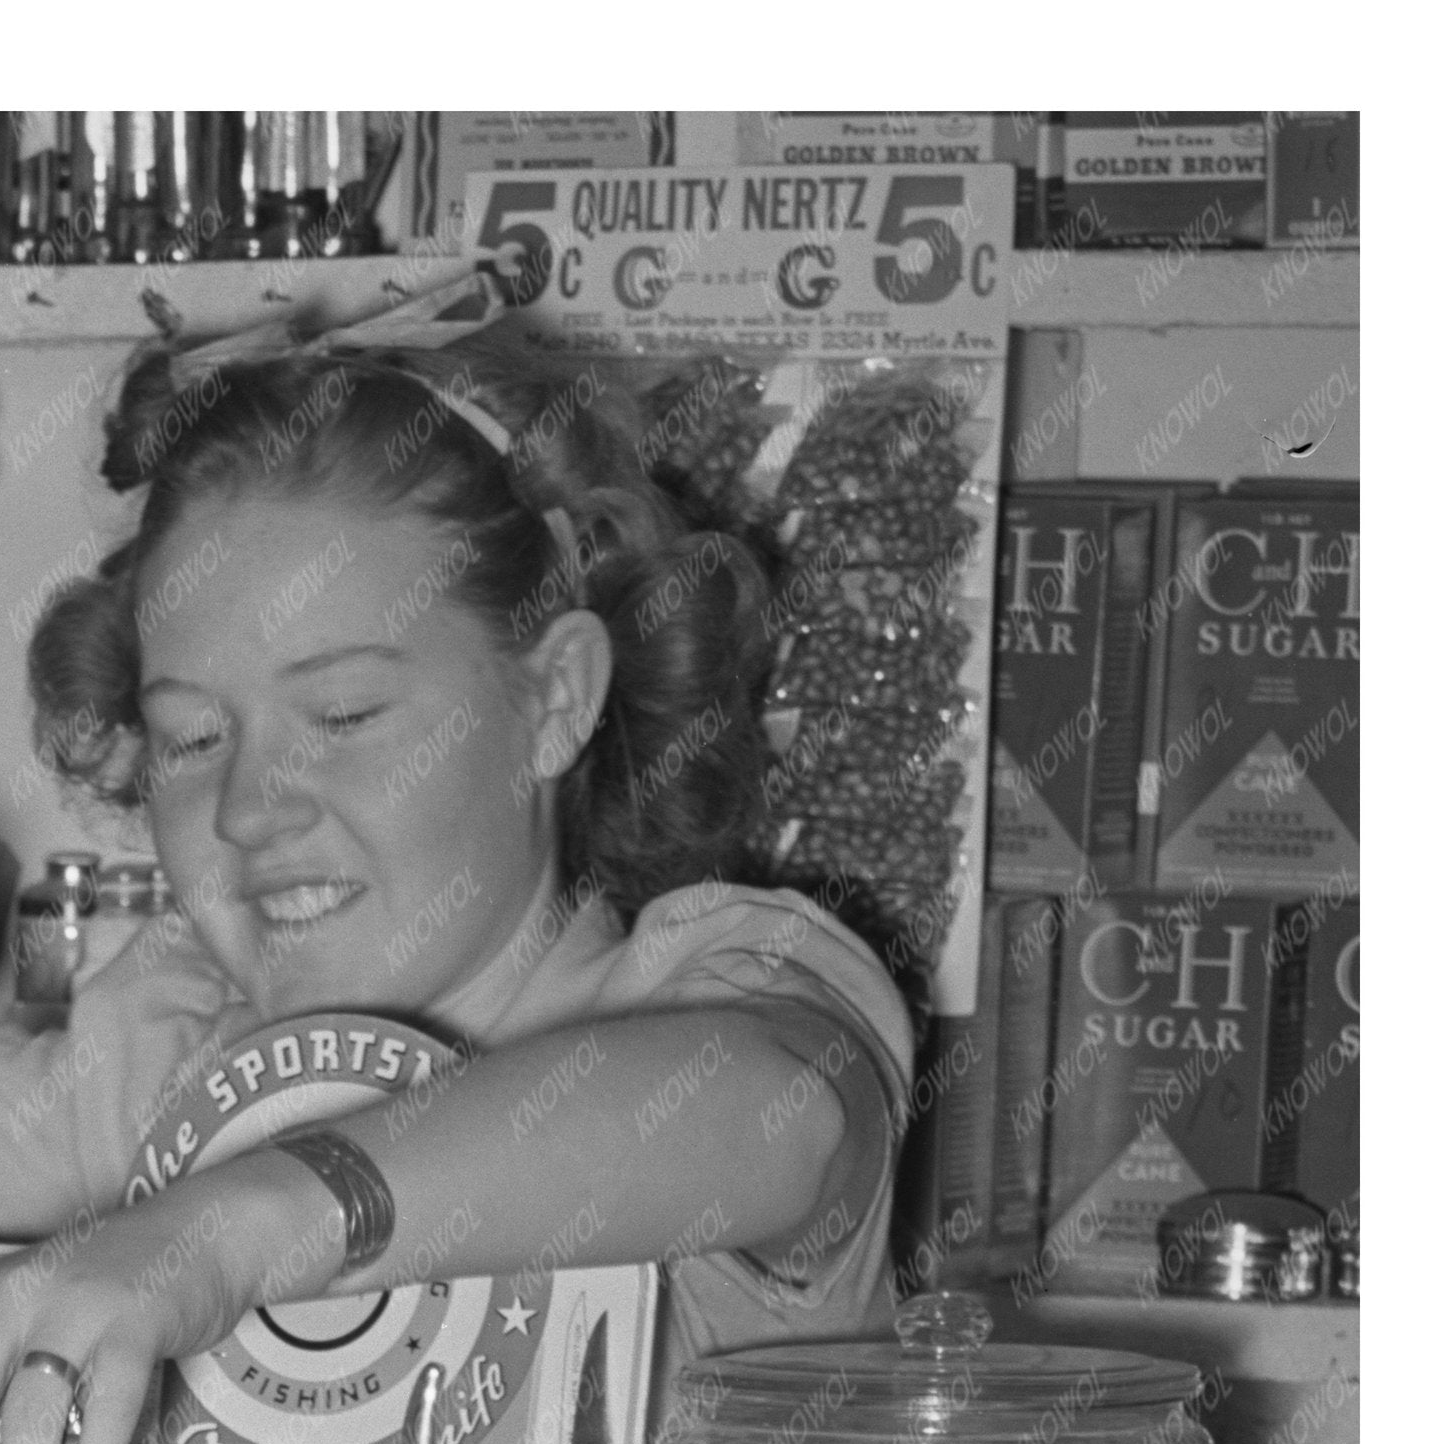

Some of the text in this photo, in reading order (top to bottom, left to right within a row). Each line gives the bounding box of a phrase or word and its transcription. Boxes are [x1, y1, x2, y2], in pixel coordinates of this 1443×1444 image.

[783, 145, 980, 164] GOLDEN BROWN
[1074, 157, 1171, 177] GOLDEN
[572, 177, 870, 239] QUALITY NERTZ
[882, 331, 949, 352] Myrtle
[1197, 621, 1360, 660] SUGAR
[1084, 1013, 1245, 1053] SUGAR
[239, 1366, 381, 1411] FISHING
